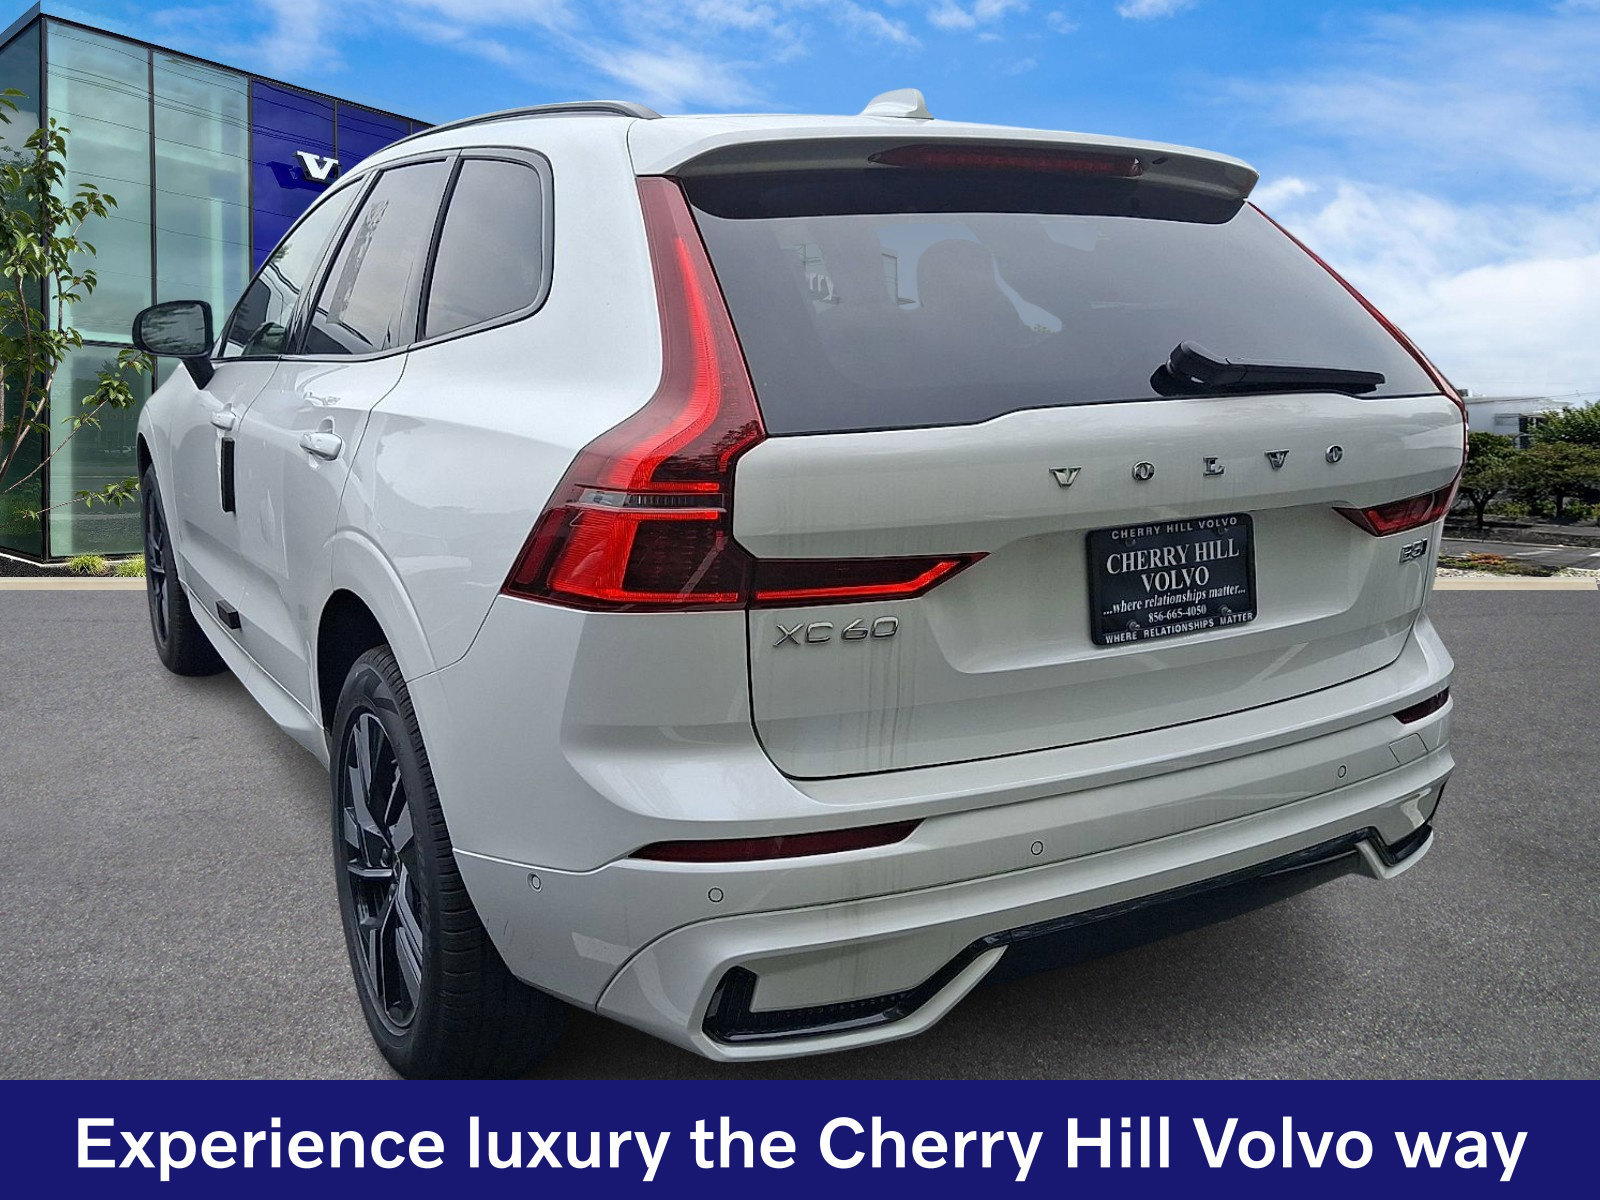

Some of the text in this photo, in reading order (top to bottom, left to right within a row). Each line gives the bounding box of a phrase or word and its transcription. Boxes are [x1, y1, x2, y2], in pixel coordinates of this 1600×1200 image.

[1049, 444, 1343, 488] VOLVO
[1111, 516, 1238, 540] CHERRY HILL VOLVO
[1106, 537, 1240, 575] CHERRY HILL
[1141, 565, 1210, 594] VOLVO
[1144, 588, 1207, 609] relationships
[1105, 612, 1254, 645] WHERE RELATIONSHIPS MATTER
[1148, 604, 1207, 624] 856-665-4050
